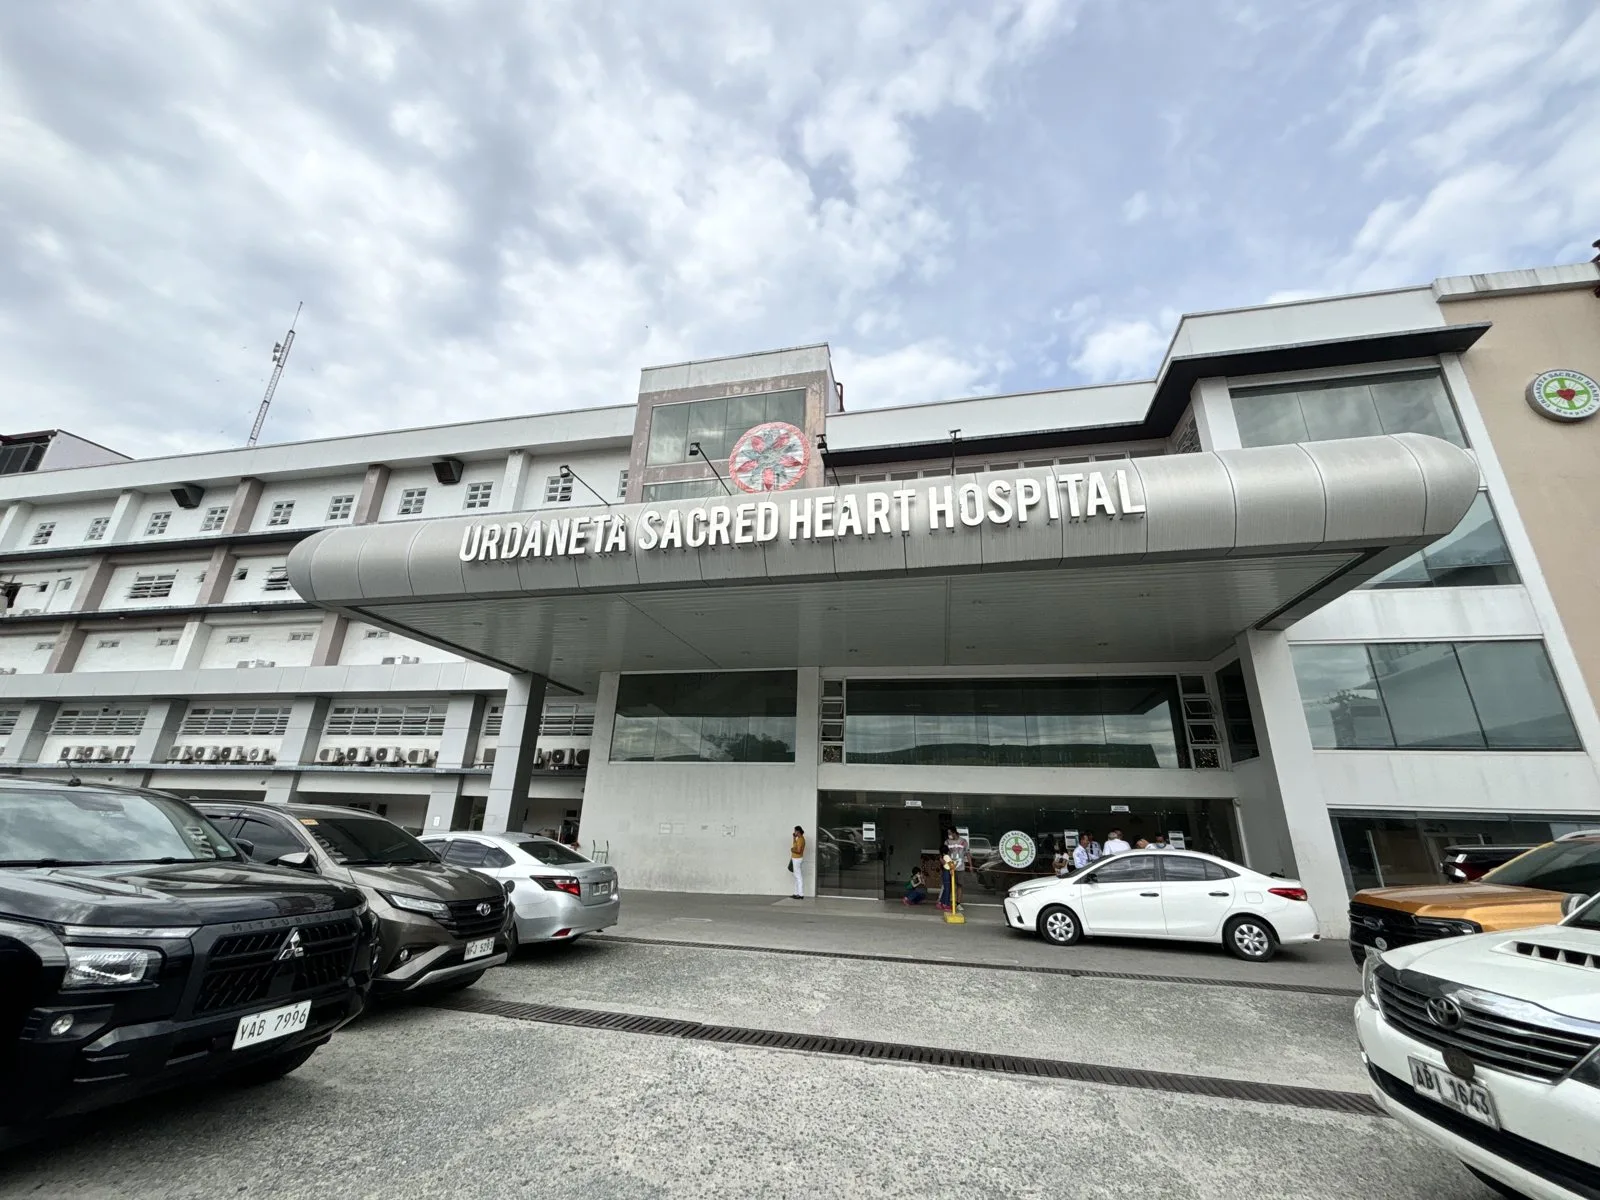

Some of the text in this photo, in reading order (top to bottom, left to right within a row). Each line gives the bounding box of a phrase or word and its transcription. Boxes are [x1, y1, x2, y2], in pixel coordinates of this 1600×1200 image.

[1548, 372, 1584, 381] SACRED
[460, 470, 1147, 563] URDANETA SACRED HEART HOSPITAL
[231, 912, 342, 932] MITSUBISHI
[240, 1008, 307, 1041] YAB 7996
[1447, 1078, 1489, 1115] 1643
